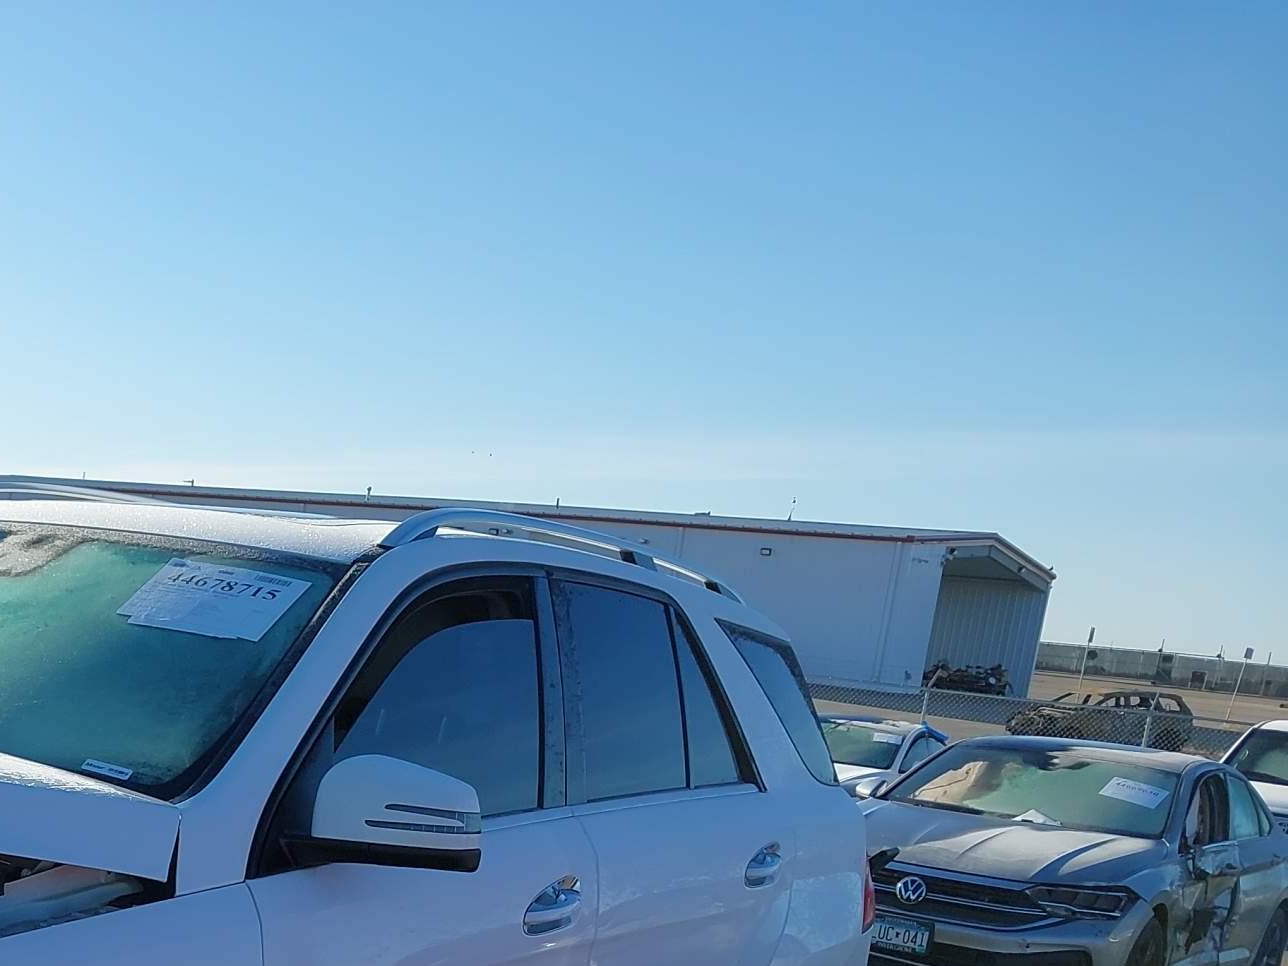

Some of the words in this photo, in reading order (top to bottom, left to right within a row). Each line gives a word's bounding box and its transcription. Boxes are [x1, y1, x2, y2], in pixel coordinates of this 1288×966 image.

[167, 571, 283, 602] 44678715
[872, 925, 895, 942] UC
[902, 929, 925, 947] 041
